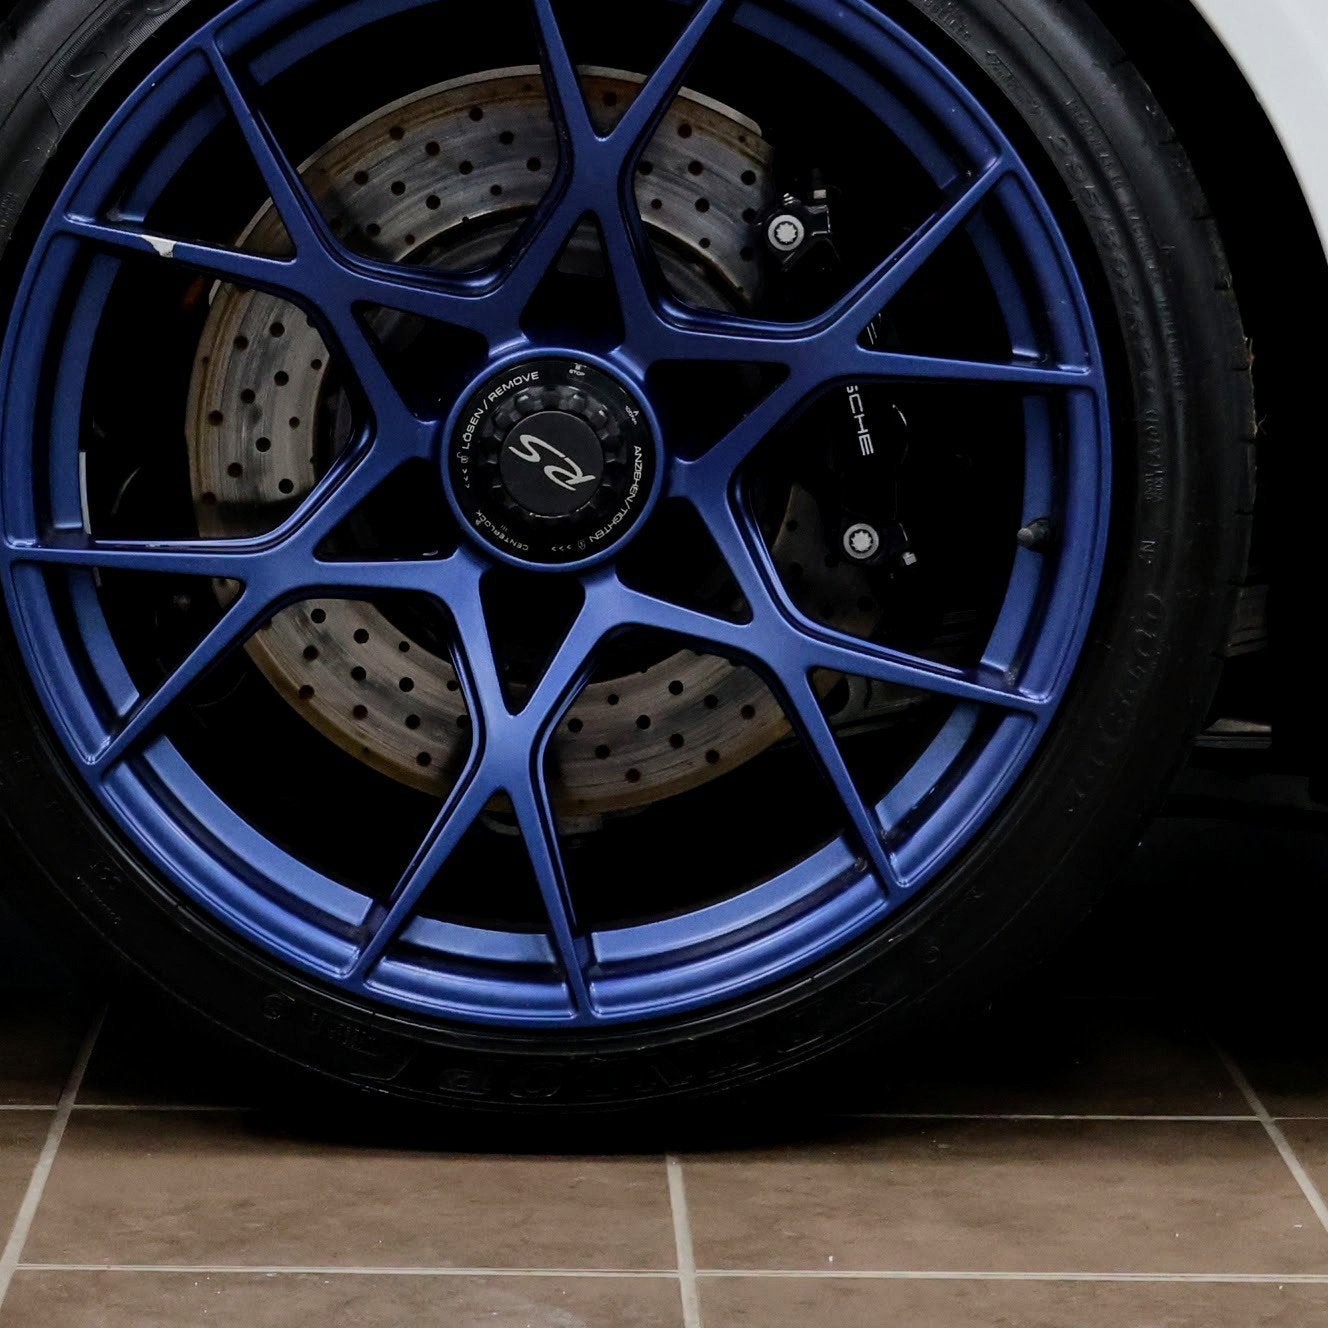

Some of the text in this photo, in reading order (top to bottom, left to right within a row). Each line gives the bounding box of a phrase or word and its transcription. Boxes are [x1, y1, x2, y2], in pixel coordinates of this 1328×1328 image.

[488, 371, 539, 402] REMOVE
[508, 434, 596, 491] RS
[476, 510, 529, 551] CENTERLOCK
